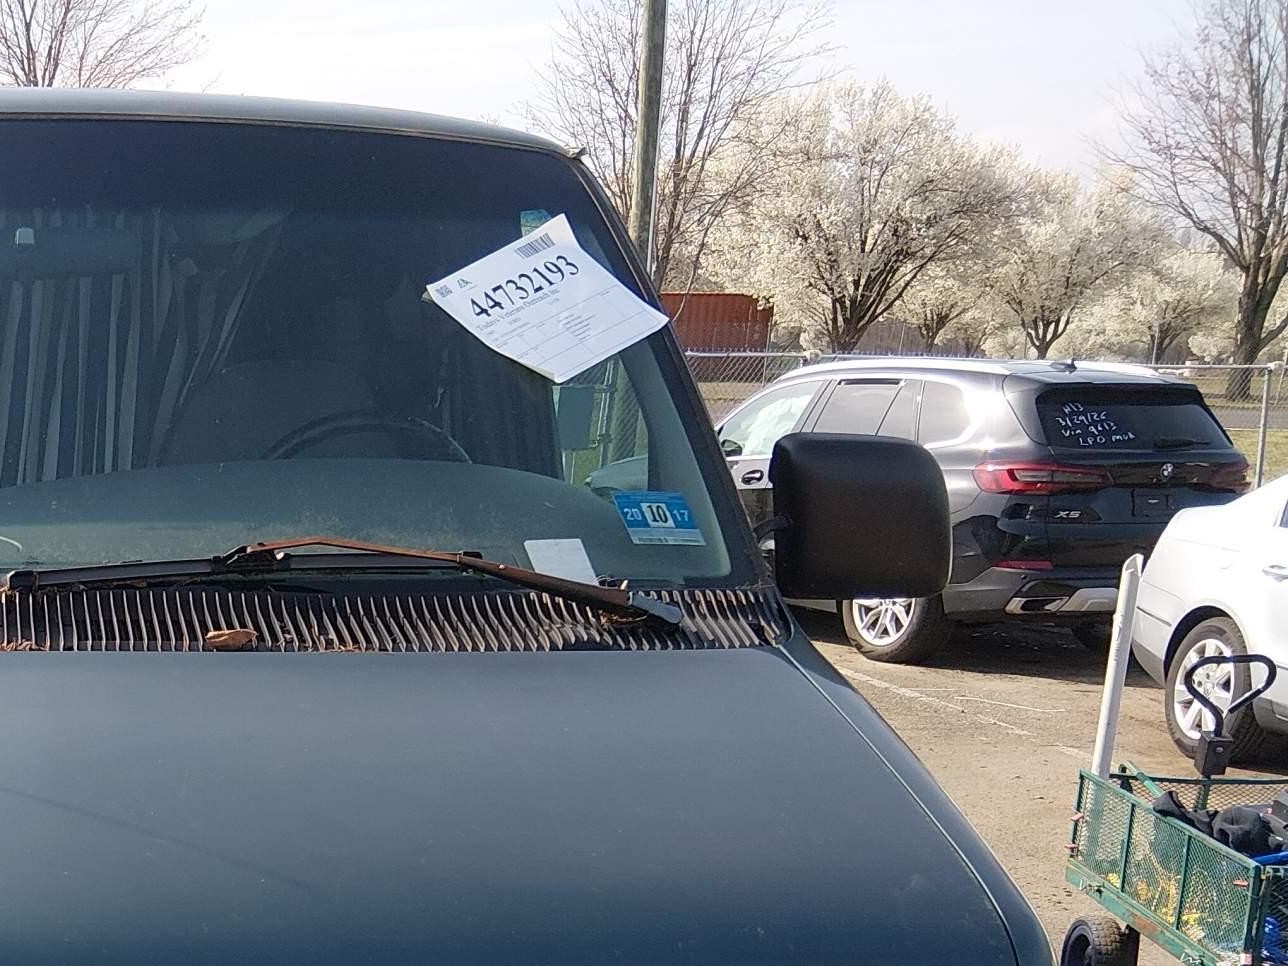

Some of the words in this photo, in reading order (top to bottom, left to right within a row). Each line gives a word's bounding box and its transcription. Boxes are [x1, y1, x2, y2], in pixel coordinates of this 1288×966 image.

[470, 255, 579, 317] 44732193
[1055, 411, 1108, 427] 3/29/26
[623, 508, 643, 521] 20
[646, 504, 669, 523] 10
[672, 509, 689, 522] 17
[1054, 510, 1081, 519] X5
